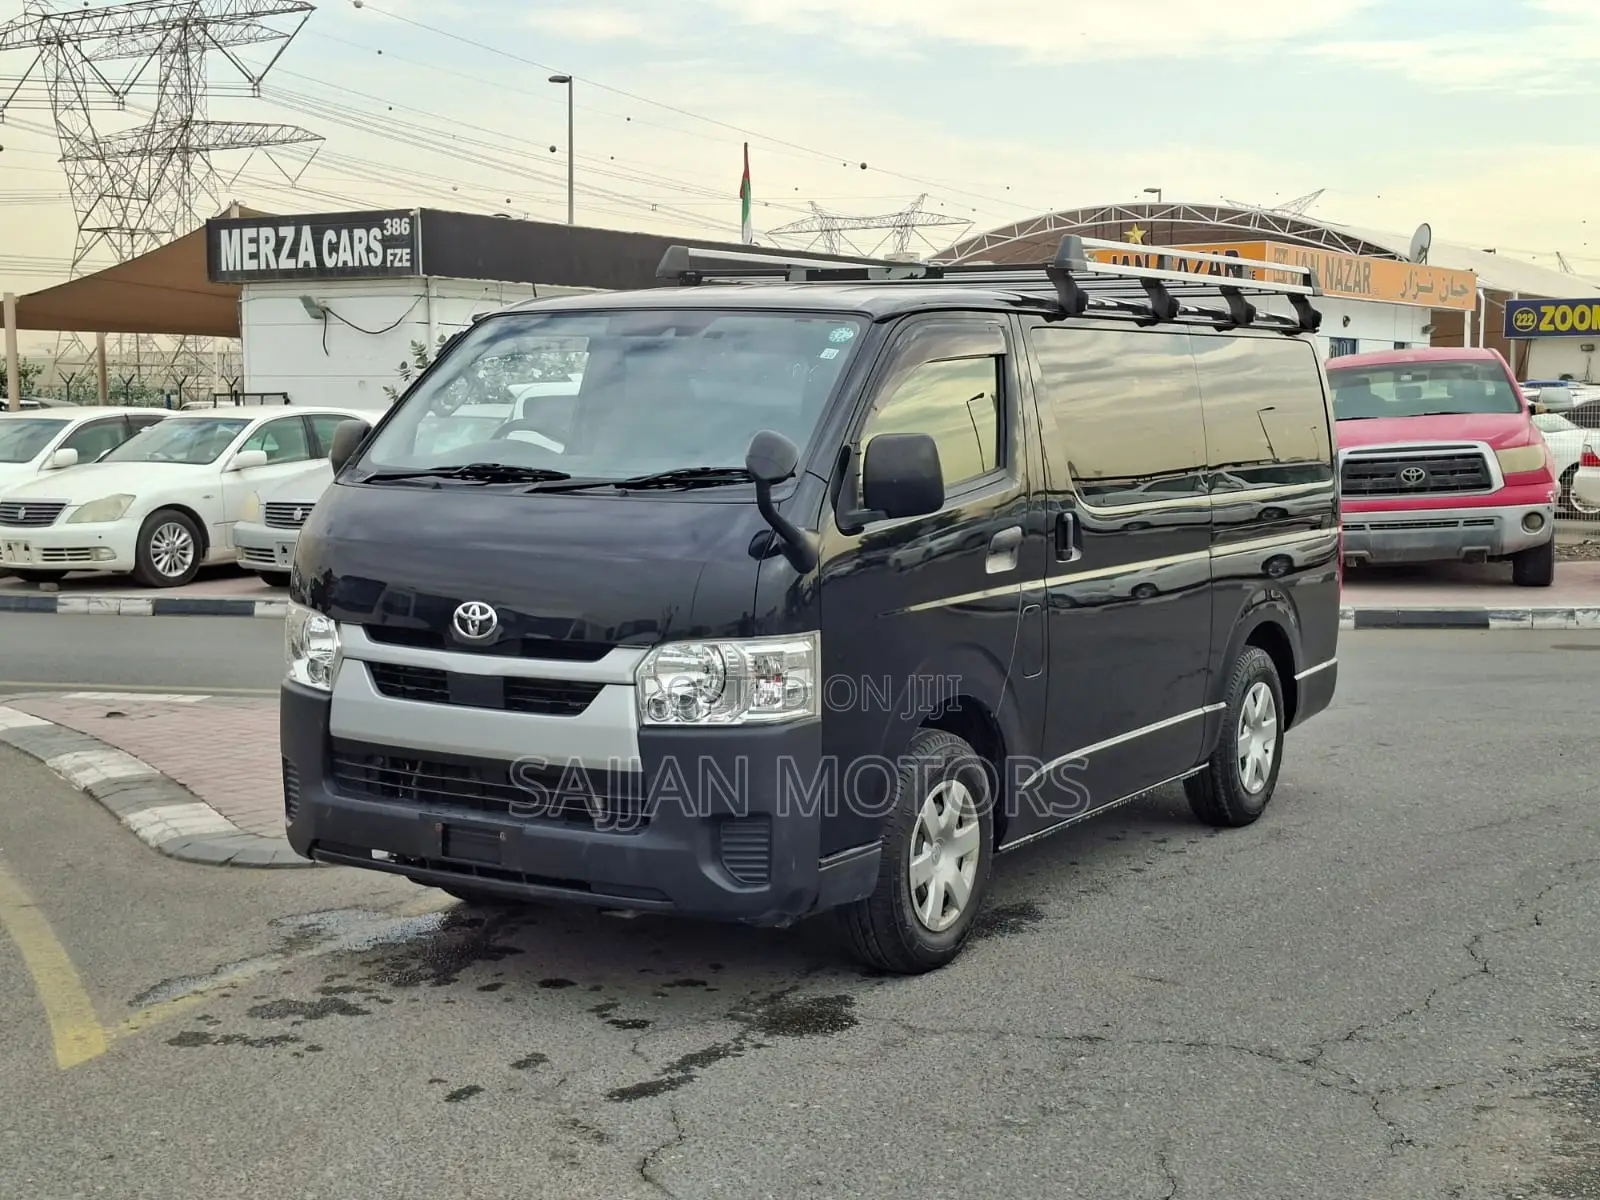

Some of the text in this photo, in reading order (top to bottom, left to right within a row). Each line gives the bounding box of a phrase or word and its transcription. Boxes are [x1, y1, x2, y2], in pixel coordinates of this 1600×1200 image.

[383, 218, 410, 236] 386
[220, 225, 383, 272] MERZA CARS
[386, 248, 411, 268] FZE
[1324, 255, 1371, 294] NAZAR
[1516, 312, 1534, 326] 222
